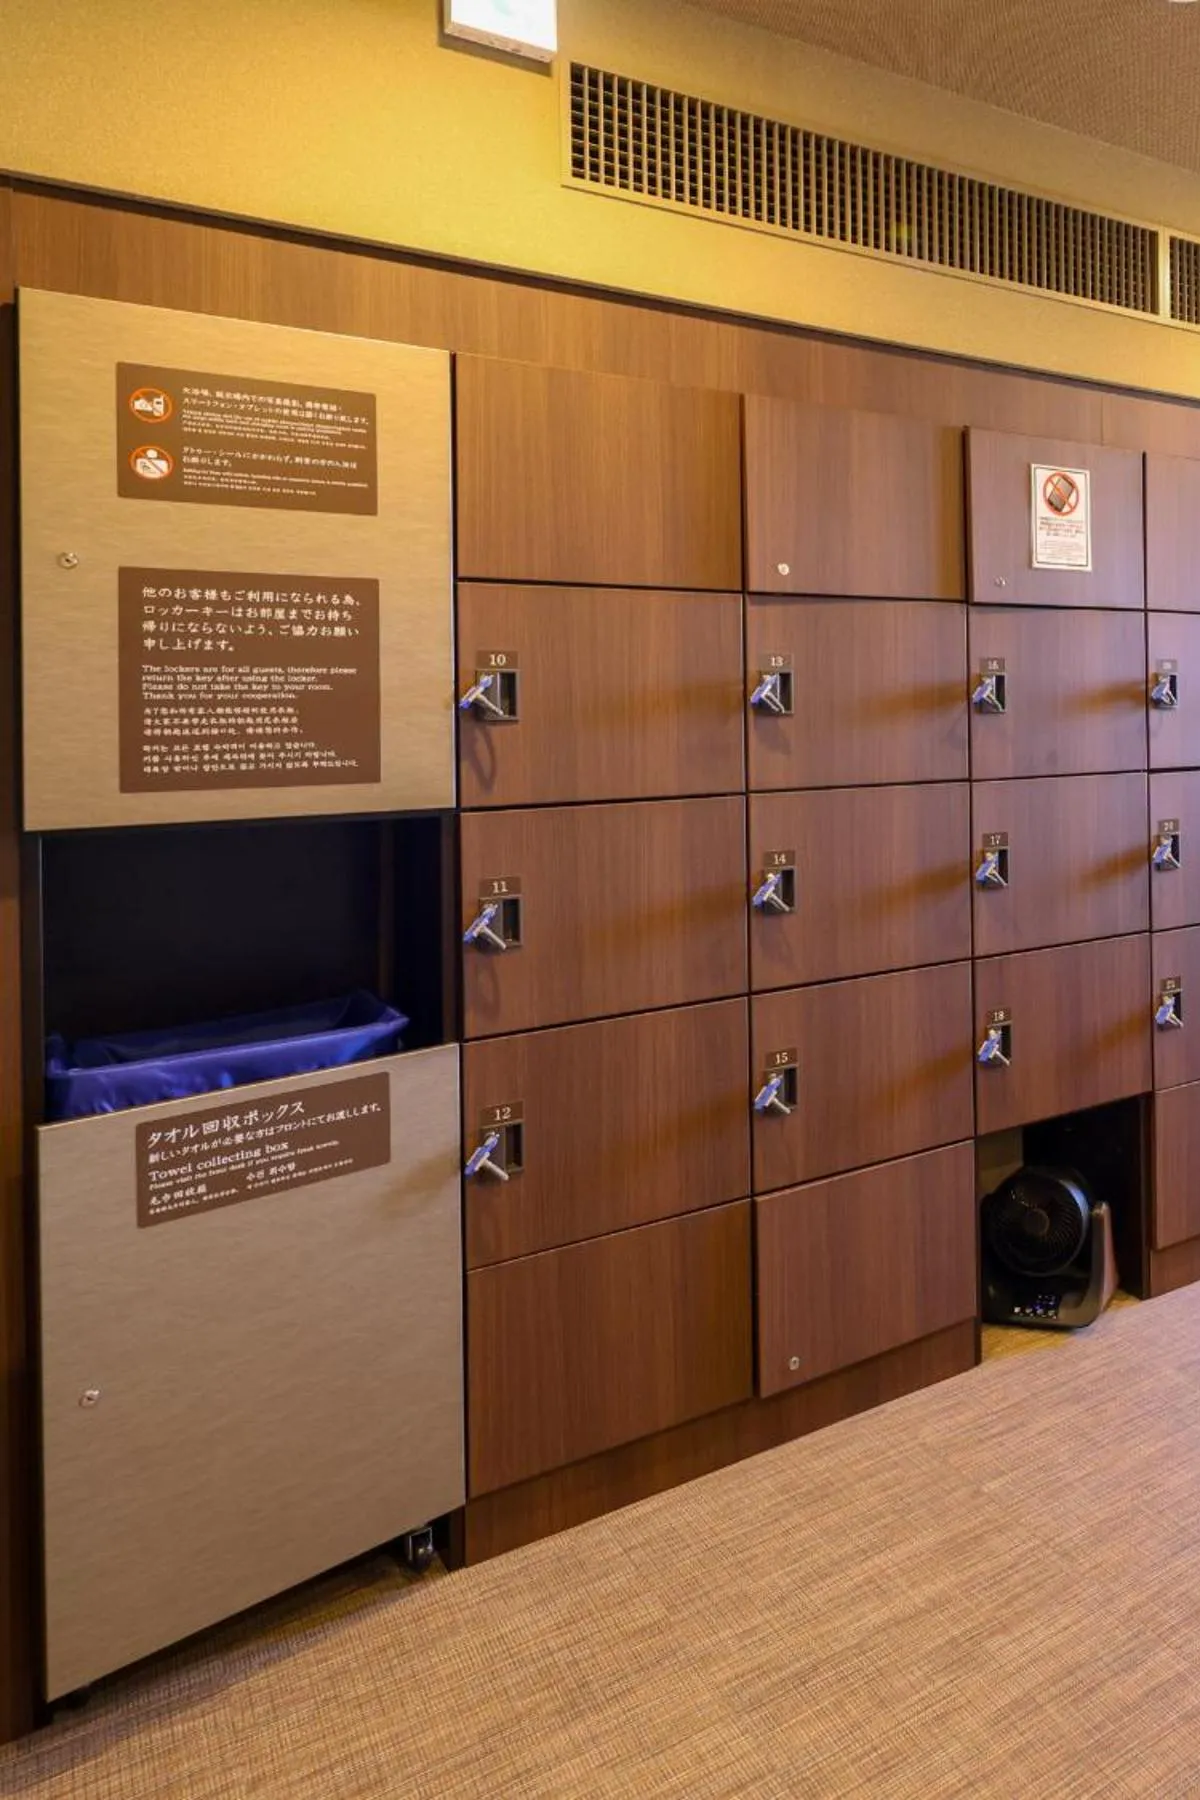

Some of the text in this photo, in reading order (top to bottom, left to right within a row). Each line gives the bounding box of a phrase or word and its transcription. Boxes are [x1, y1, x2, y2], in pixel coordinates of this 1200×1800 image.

[143, 637, 235, 651] 申し上げます。
[489, 653, 507, 666] 10
[770, 655, 784, 667] 13
[773, 853, 787, 865] 14
[493, 881, 509, 894] 11
[775, 1051, 788, 1064] 15
[494, 1107, 511, 1121] 12
[148, 1101, 305, 1149] タオル回収ボックス
[148, 1142, 289, 1181] Towel collecting box
